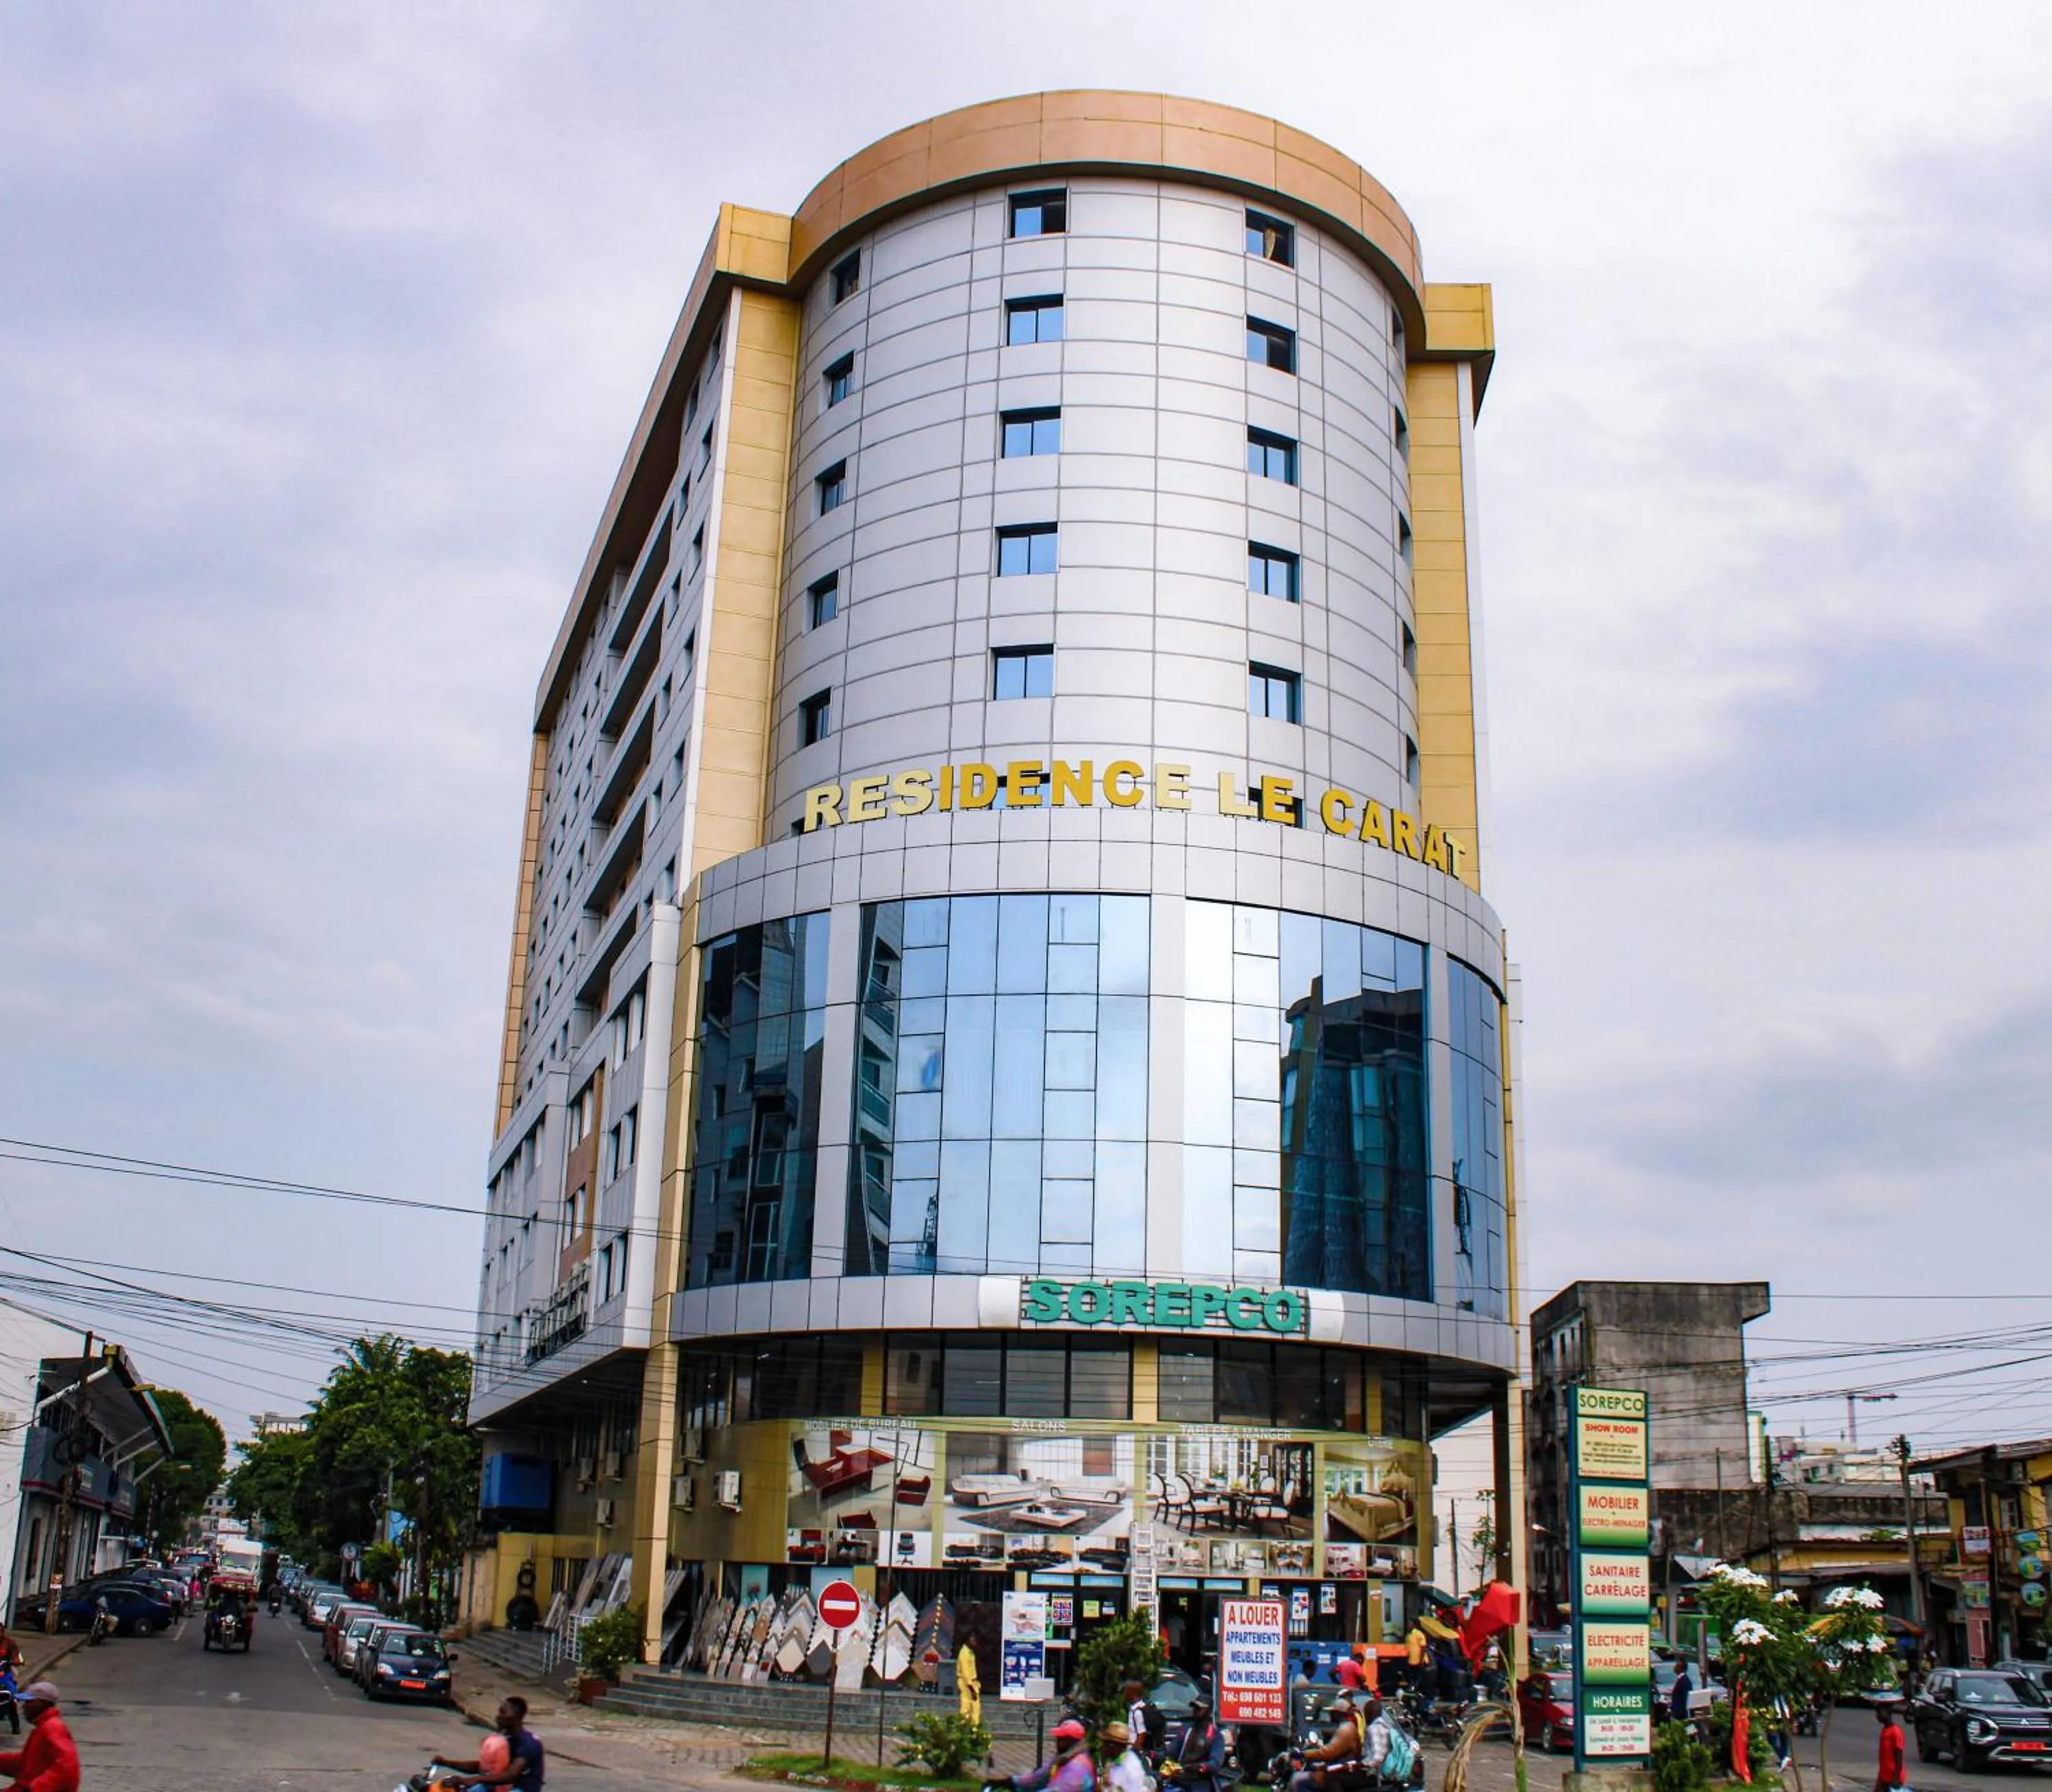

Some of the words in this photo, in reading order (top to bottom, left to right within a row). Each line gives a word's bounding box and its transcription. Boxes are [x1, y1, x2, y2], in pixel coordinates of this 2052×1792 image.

[803, 760, 1192, 832] RESIDENCE
[1218, 772, 1296, 825] LE
[1320, 789, 1466, 880] CARAT
[1025, 1280, 1303, 1333] SOREPCO
[1579, 1394, 1644, 1411] SOREPCO
[1011, 1420, 1066, 1433] SALONS
[1181, 1425, 1228, 1436] TABLES
[1243, 1427, 1292, 1440] MANGER
[1585, 1423, 1609, 1432] SHOW
[1588, 1496, 1639, 1510] MOBILIER
[1589, 1564, 1640, 1578] SANITAIRE
[1584, 1584, 1646, 1597] CARRELAGE
[1228, 1605, 1236, 1625] A
[1239, 1606, 1278, 1626] LOUER
[1225, 1631, 1281, 1646] APPARTEMENTS
[1231, 1650, 1263, 1664] MEUBLES
[1266, 1652, 1274, 1664] ET
[1587, 1657, 1645, 1667] APPAREILLAGE
[1227, 1670, 1242, 1683] NON
[1244, 1672, 1278, 1684] MEUBLES
[1593, 1696, 1642, 1708] HORAIRES
